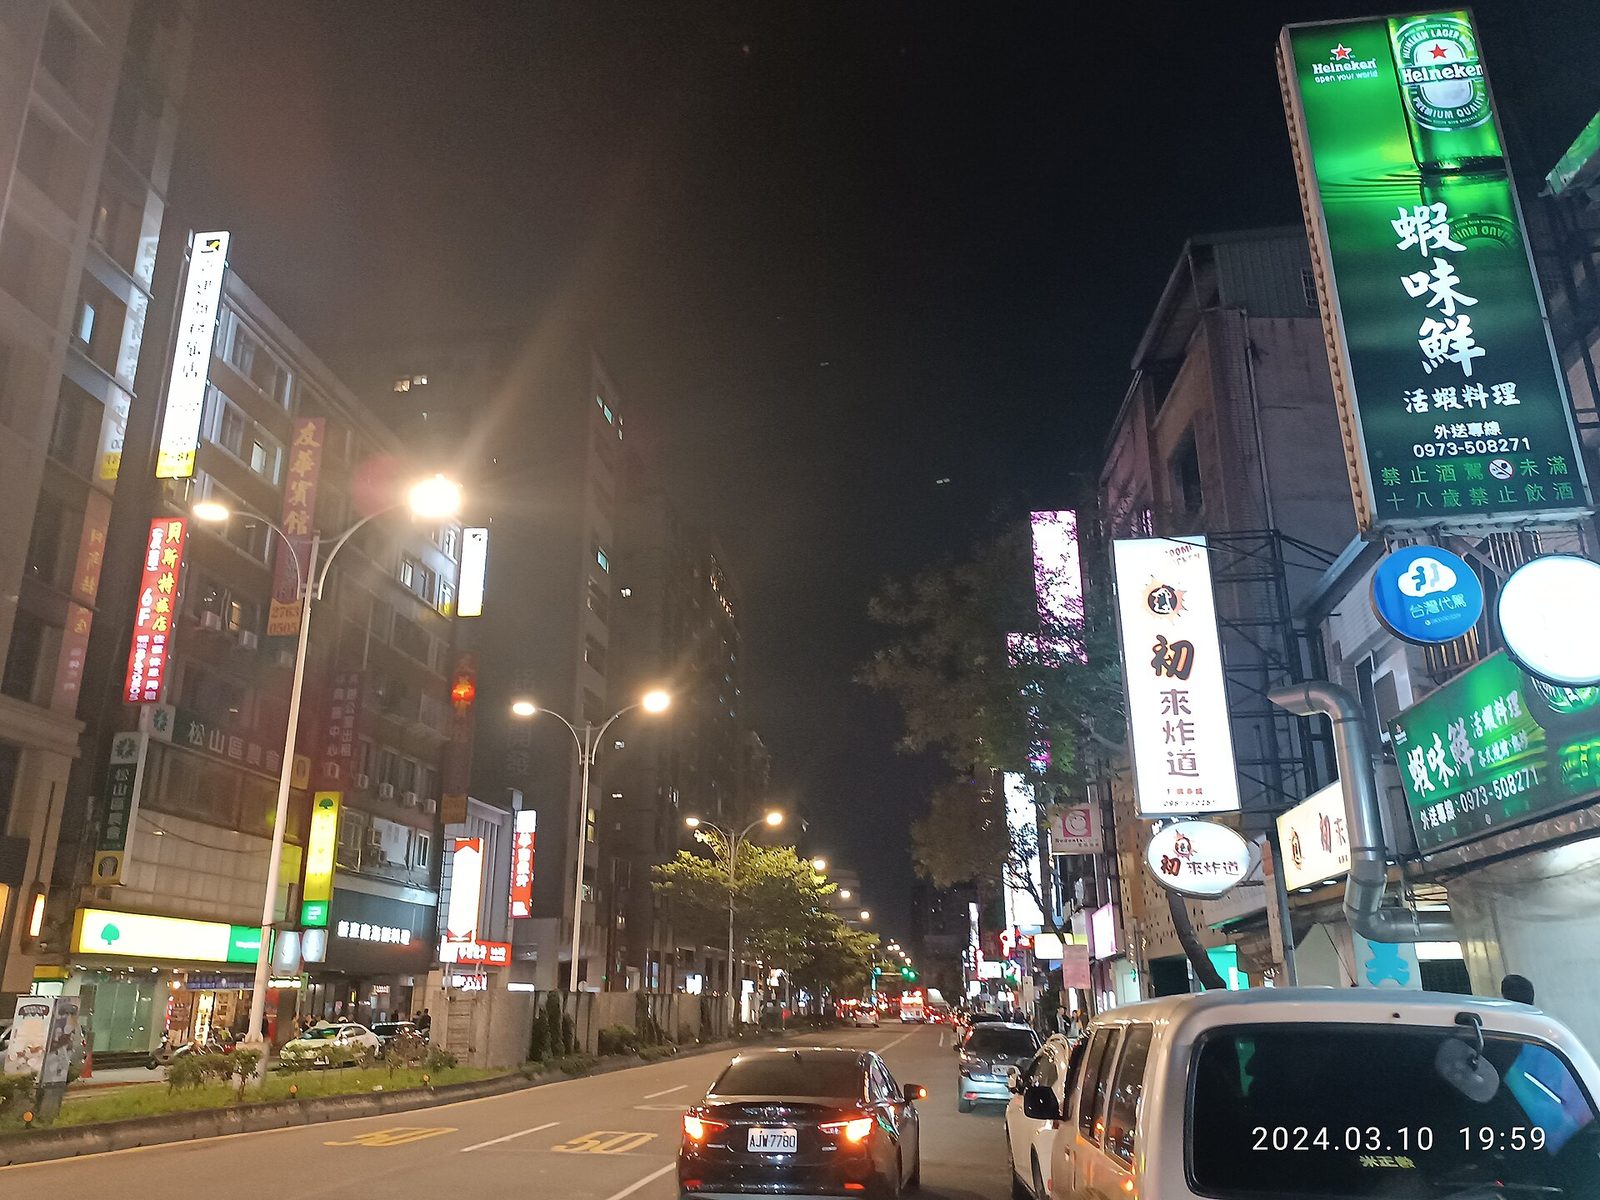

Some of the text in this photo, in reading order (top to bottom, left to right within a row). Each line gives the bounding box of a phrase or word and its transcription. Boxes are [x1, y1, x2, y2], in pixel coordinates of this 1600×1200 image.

[1430, 28, 1460, 39] LAGER
[1312, 58, 1377, 75] Heineken
[1314, 70, 1378, 84] open your world
[1401, 64, 1484, 84] Heineken
[1413, 96, 1454, 119] PREMIUM
[1391, 202, 1486, 377] 蝦味鮮
[1403, 381, 1521, 414] 活蝦料理
[1434, 421, 1502, 440] 外送專線
[1413, 437, 1531, 459] 0973-508271
[1381, 456, 1569, 486] 禁止酒駕 未滿
[1386, 482, 1575, 512] 十八歲禁止飲酒
[1409, 593, 1467, 619] 台灣代駕
[1150, 634, 1200, 778] 初來炸道
[1406, 716, 1475, 798] 蝦味鮮
[1459, 764, 1540, 813] 0973-508271
[1160, 854, 1240, 877] 初來炸道
[550, 1131, 659, 1154] 50
